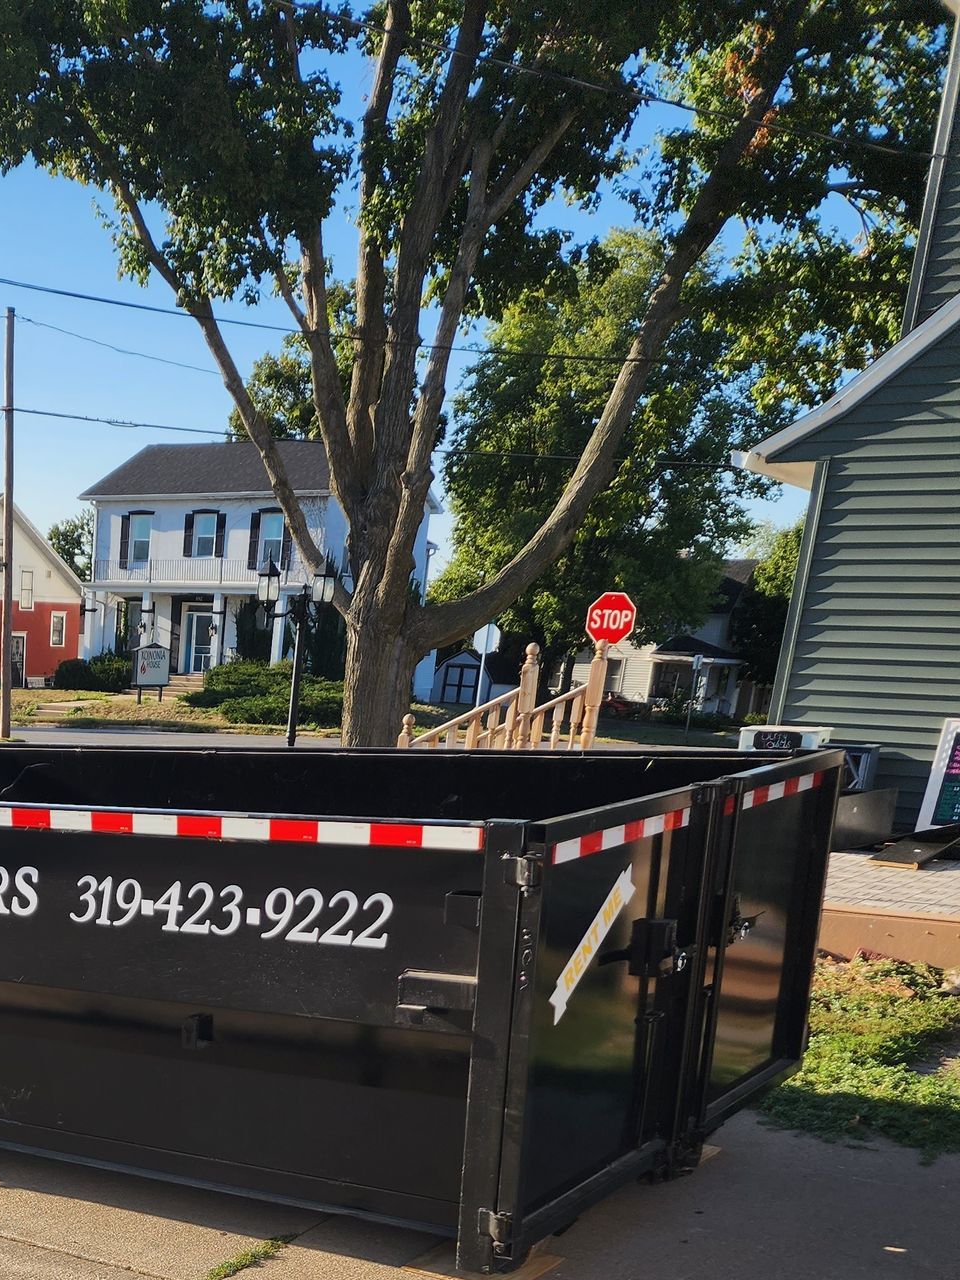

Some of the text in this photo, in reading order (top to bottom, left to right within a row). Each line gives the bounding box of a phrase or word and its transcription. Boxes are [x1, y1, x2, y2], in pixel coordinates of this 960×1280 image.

[590, 609, 632, 630] STOP
[68, 874, 395, 949] 319-423-9222
[562, 885, 623, 993] RENT ME
